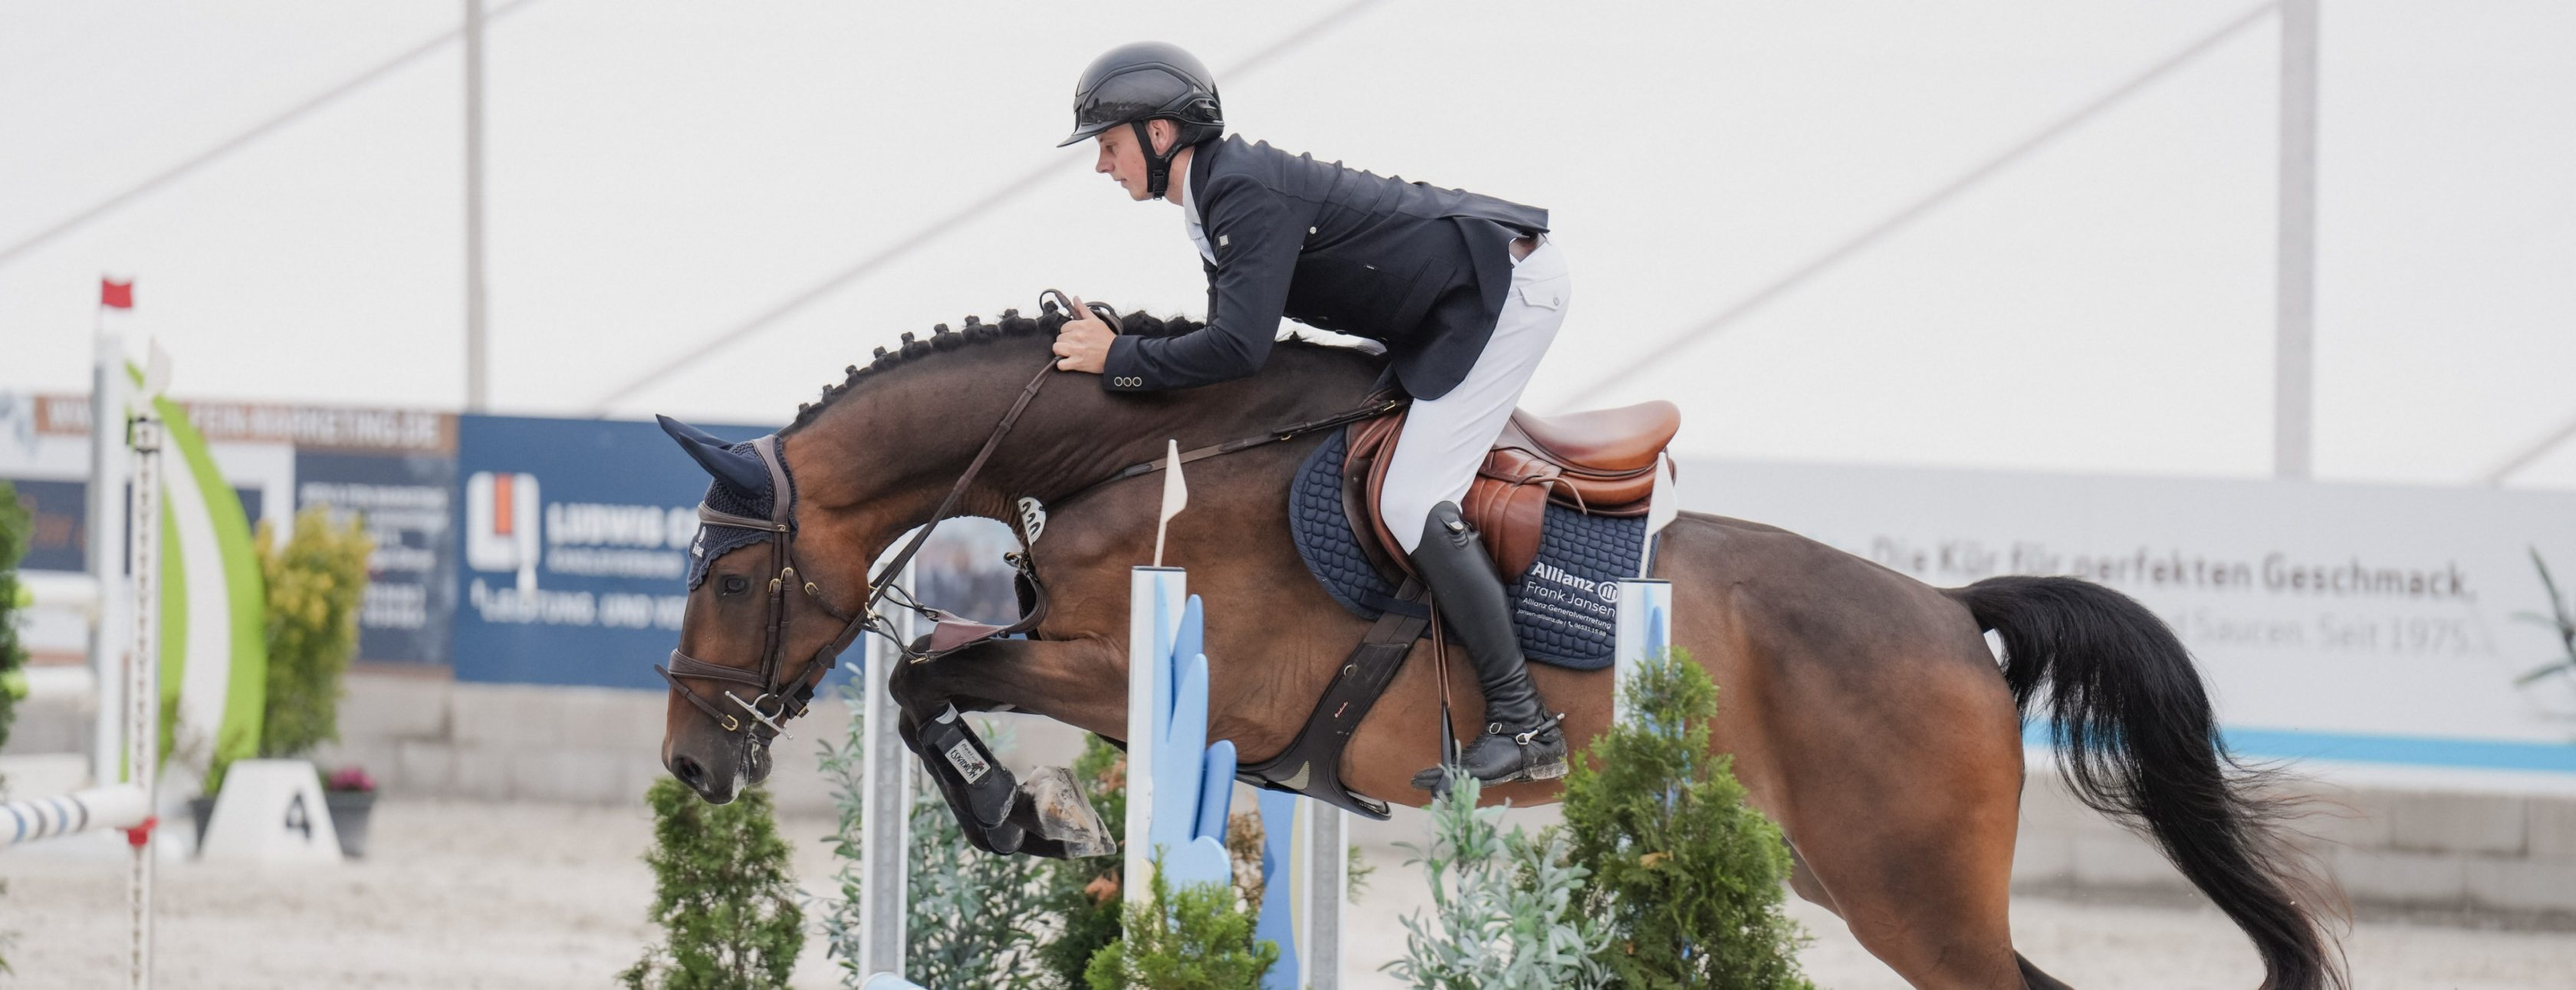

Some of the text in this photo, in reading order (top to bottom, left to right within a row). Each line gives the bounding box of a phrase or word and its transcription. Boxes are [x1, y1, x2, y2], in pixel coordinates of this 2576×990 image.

[1531, 561, 1595, 592] Allianz
[1523, 597, 1612, 630] Allianz Generalvertretung
[1526, 581, 1616, 617] Frank Jansen
[285, 789, 311, 840] 4
